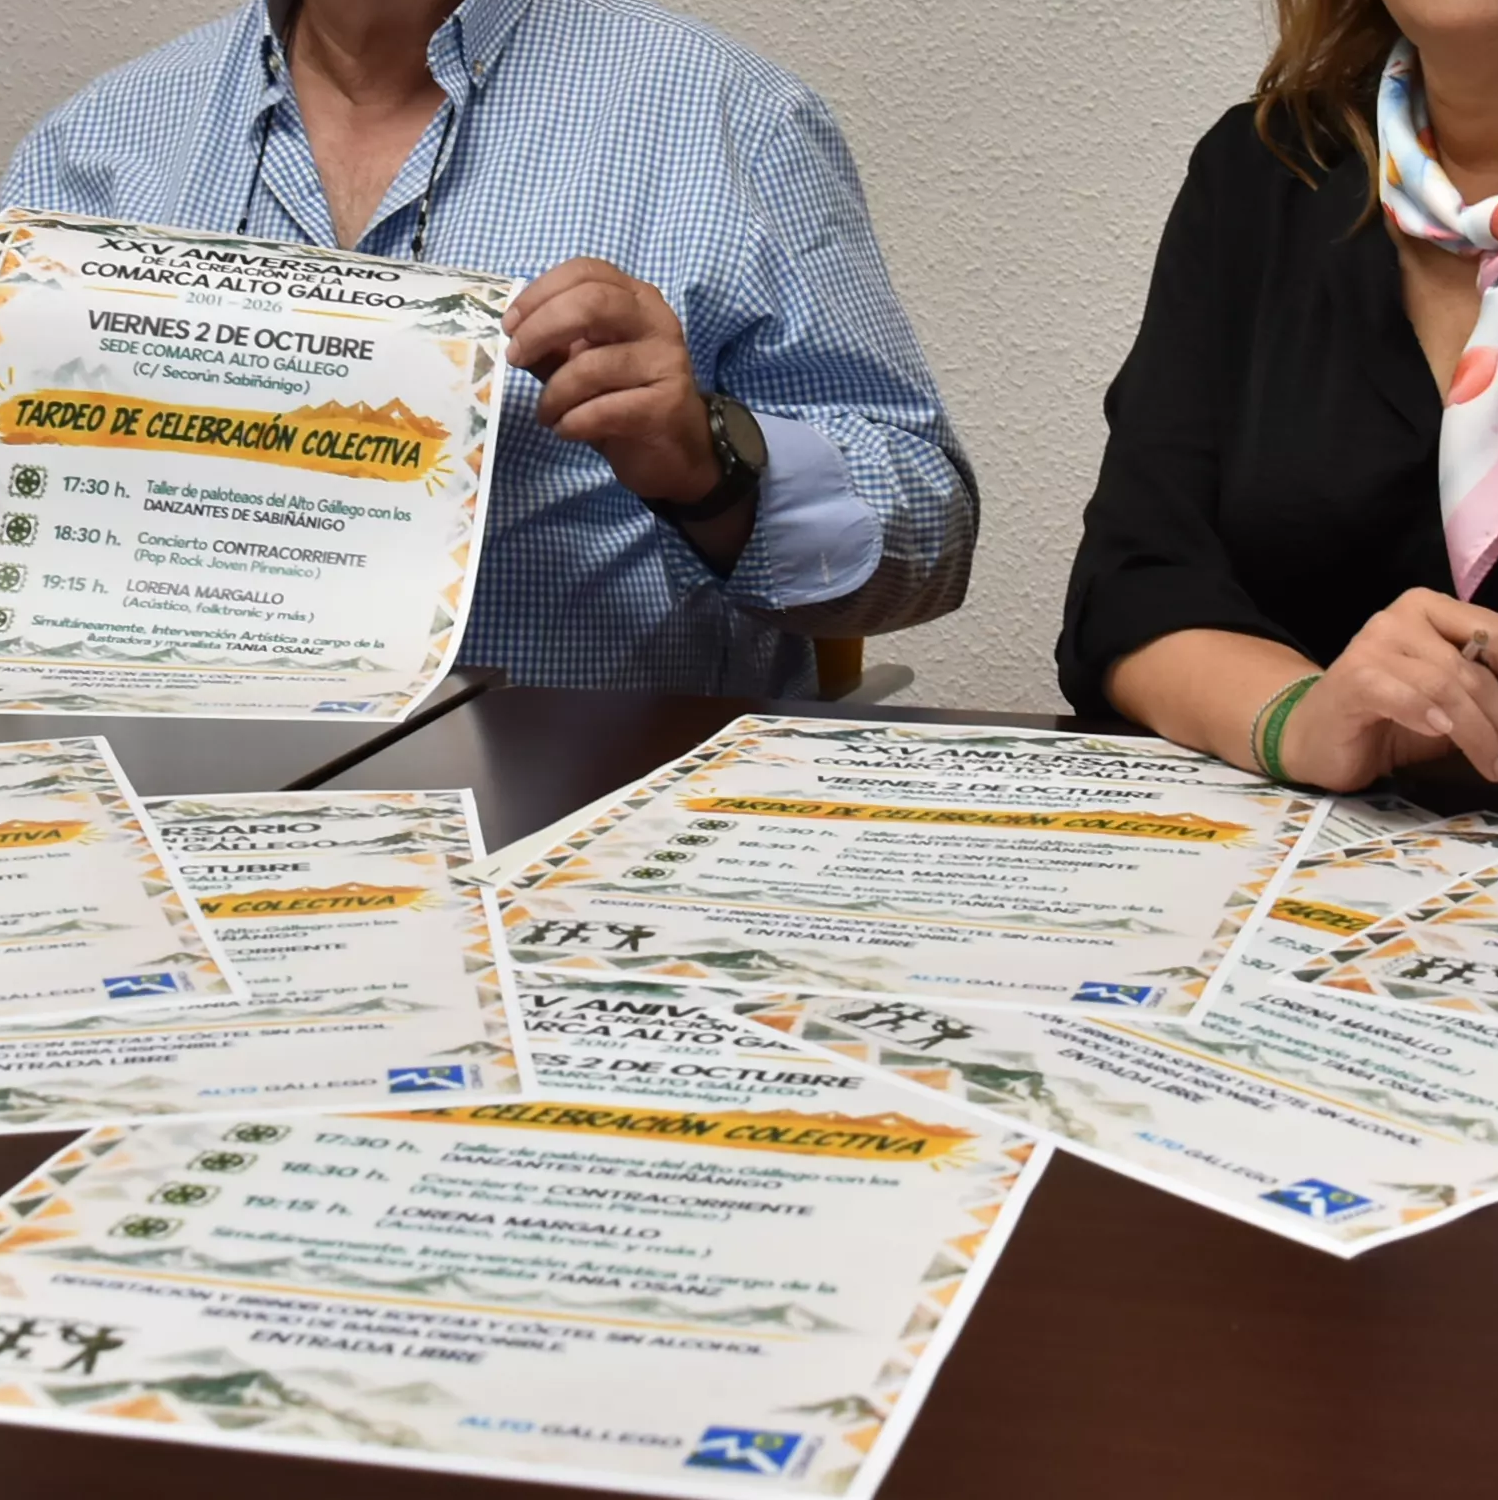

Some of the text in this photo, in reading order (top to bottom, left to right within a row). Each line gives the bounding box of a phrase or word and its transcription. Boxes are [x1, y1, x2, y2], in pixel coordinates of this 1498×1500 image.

[97, 238, 400, 282] XXV ANIVERSARIO
[142, 256, 342, 286] DE LA CREACIÓN DE LA
[81, 262, 405, 309] COMARCA ALTO GÁLLEGO
[185, 292, 223, 307] 2001
[242, 298, 283, 313] 2026
[88, 310, 375, 360] VIERNES 2 DE OCTUBRE
[100, 338, 348, 377] SEDE COMARCA ALTO GÁLLEGO
[133, 361, 159, 378] (C/
[163, 364, 219, 383] Secorún
[16, 400, 422, 468] TARDEO DE CELEBRACIÓN COLECTIVA
[62, 476, 131, 498] 17:30 h.
[146, 480, 178, 496] Taller
[181, 485, 198, 497] de
[266, 491, 286, 507] del
[288, 494, 314, 510] Alto
[317, 497, 365, 519] Gállego
[367, 506, 391, 520] con
[394, 508, 412, 522] los
[143, 498, 345, 532] DANZANTES DE SABIÑÁNIGO
[53, 525, 121, 546] 18:30 h.
[137, 532, 366, 568] Concierto CONTRACORRIENTE
[134, 548, 165, 566] (Pop
[170, 552, 202, 568] Rock
[206, 557, 247, 572] Joven
[42, 574, 109, 594] 19:15 h.
[127, 579, 284, 605] LORENA MARGALLO
[123, 595, 191, 614] (Acústico,
[196, 602, 262, 620] folktronic
[265, 609, 274, 622] y
[152, 624, 236, 640] Intervención
[240, 631, 298, 645] Artística
[301, 637, 309, 646] a
[313, 637, 351, 650] cargo
[354, 640, 371, 649] de
[374, 641, 384, 649] la
[154, 640, 162, 649] y
[225, 641, 268, 653] TANIA
[272, 645, 324, 655] OSANZ
[816, 775, 1161, 800] VIERNES 2 DE OCTUBRE
[712, 800, 1218, 840] TARDEO DE CELEBRACIÓN COLECTIVA
[231, 894, 396, 913] COLECTIVA
[595, 1014, 739, 1032] CREACIÓN
[585, 1058, 864, 1089] 2 DE OCTUBRE
[314, 1132, 422, 1153] 17:30 h.
[469, 1105, 926, 1154] CELEBRACIÓN COLECTIVA
[280, 1161, 390, 1183] 18:30 h.
[441, 1152, 784, 1189] DANZANTES DE SABIÑÁNIGO
[548, 1185, 814, 1216] CONTRACORRIENTE
[385, 1205, 661, 1239] LORENA MARGALLO
[250, 1329, 487, 1364] ENTRADA LIBRE
